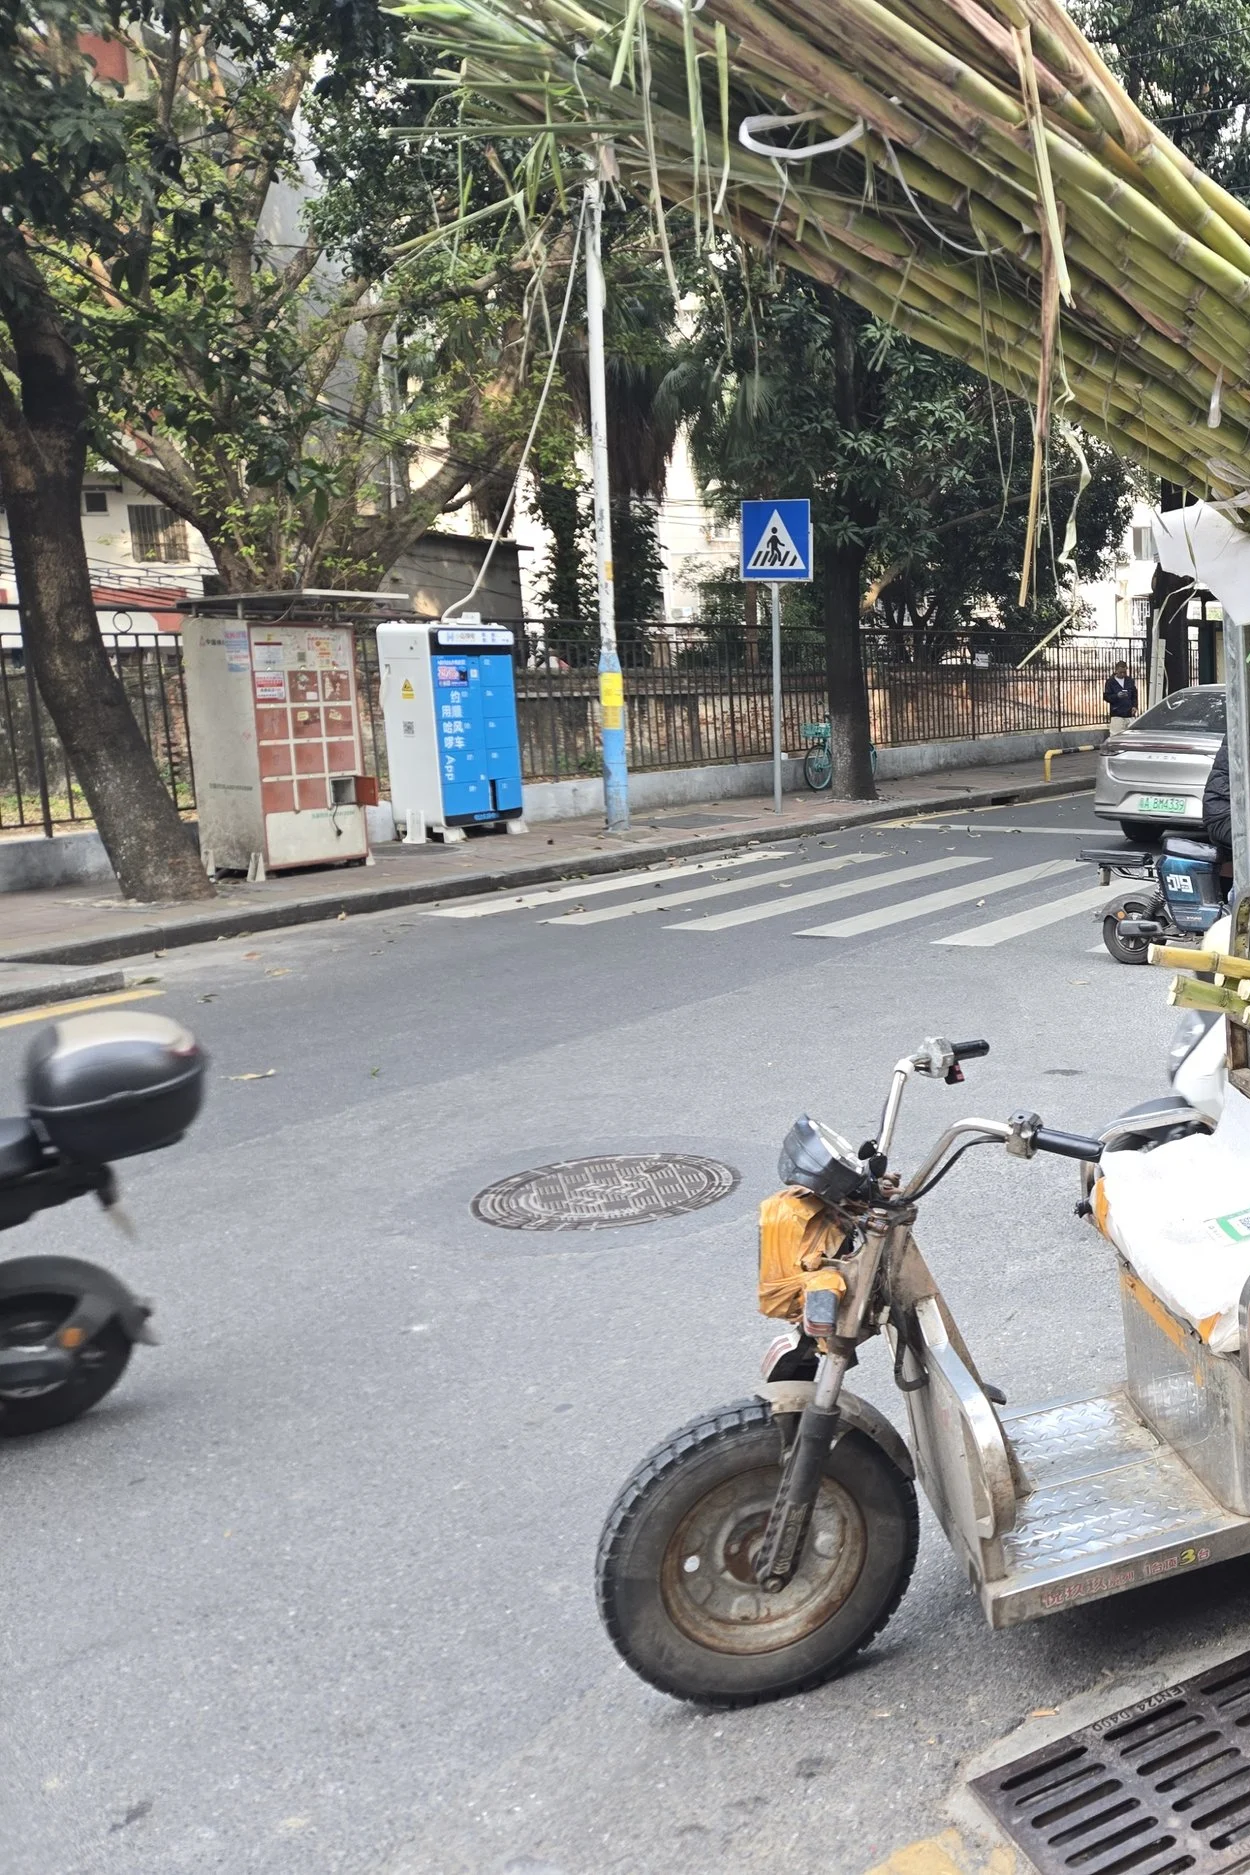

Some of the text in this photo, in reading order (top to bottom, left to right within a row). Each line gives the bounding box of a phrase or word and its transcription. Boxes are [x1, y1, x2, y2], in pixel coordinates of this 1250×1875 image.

[450, 690, 465, 749] 约顺风车
[445, 755, 456, 781] App
[1091, 1685, 1185, 1733] EN124 D400
